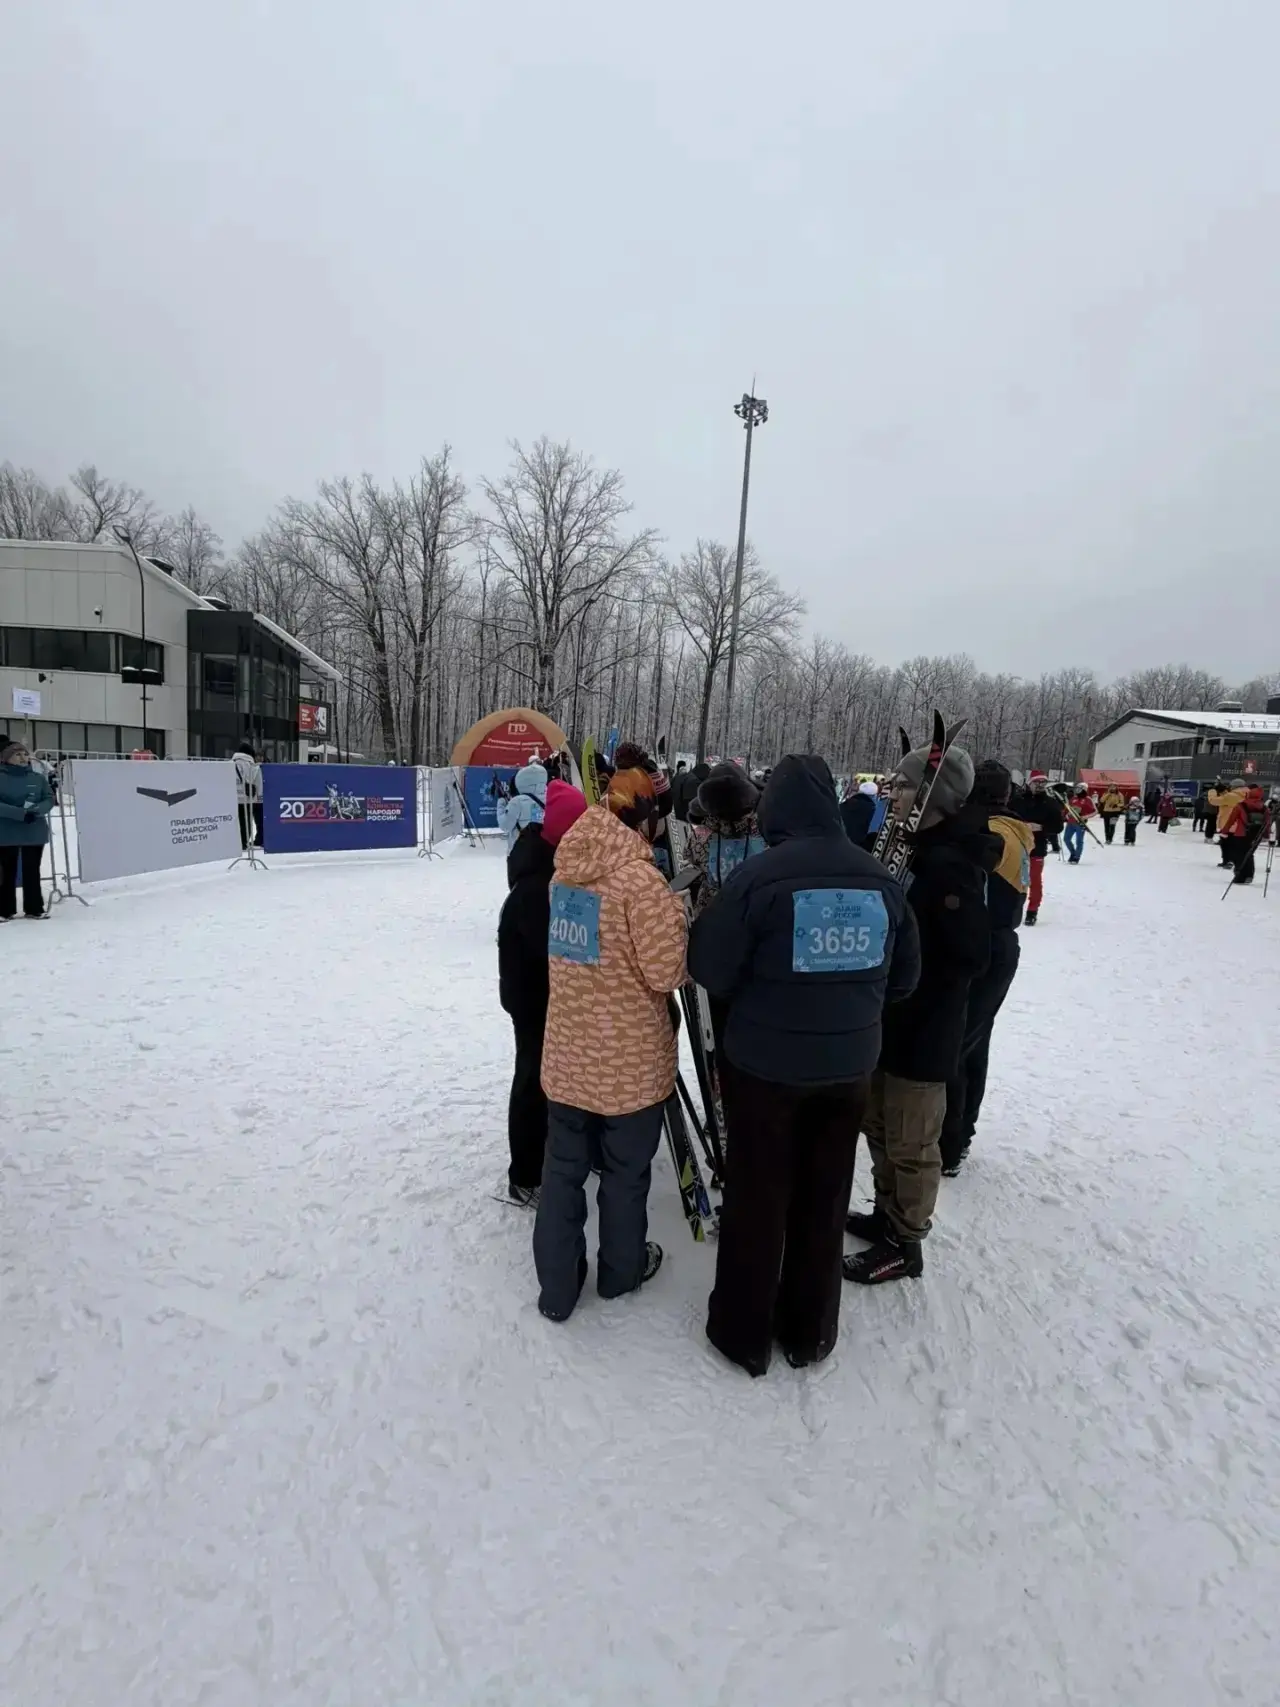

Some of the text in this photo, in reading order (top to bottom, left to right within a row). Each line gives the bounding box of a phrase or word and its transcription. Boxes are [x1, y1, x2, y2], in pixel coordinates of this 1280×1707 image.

[280, 802, 328, 818] 2026
[170, 815, 233, 826] ПРАВИТЕЛЬСТВО
[171, 824, 218, 836] САМАРСКОЙ
[172, 834, 208, 844] ОБЛАСТИ
[550, 917, 588, 946] 4000
[808, 926, 871, 954] 3655
